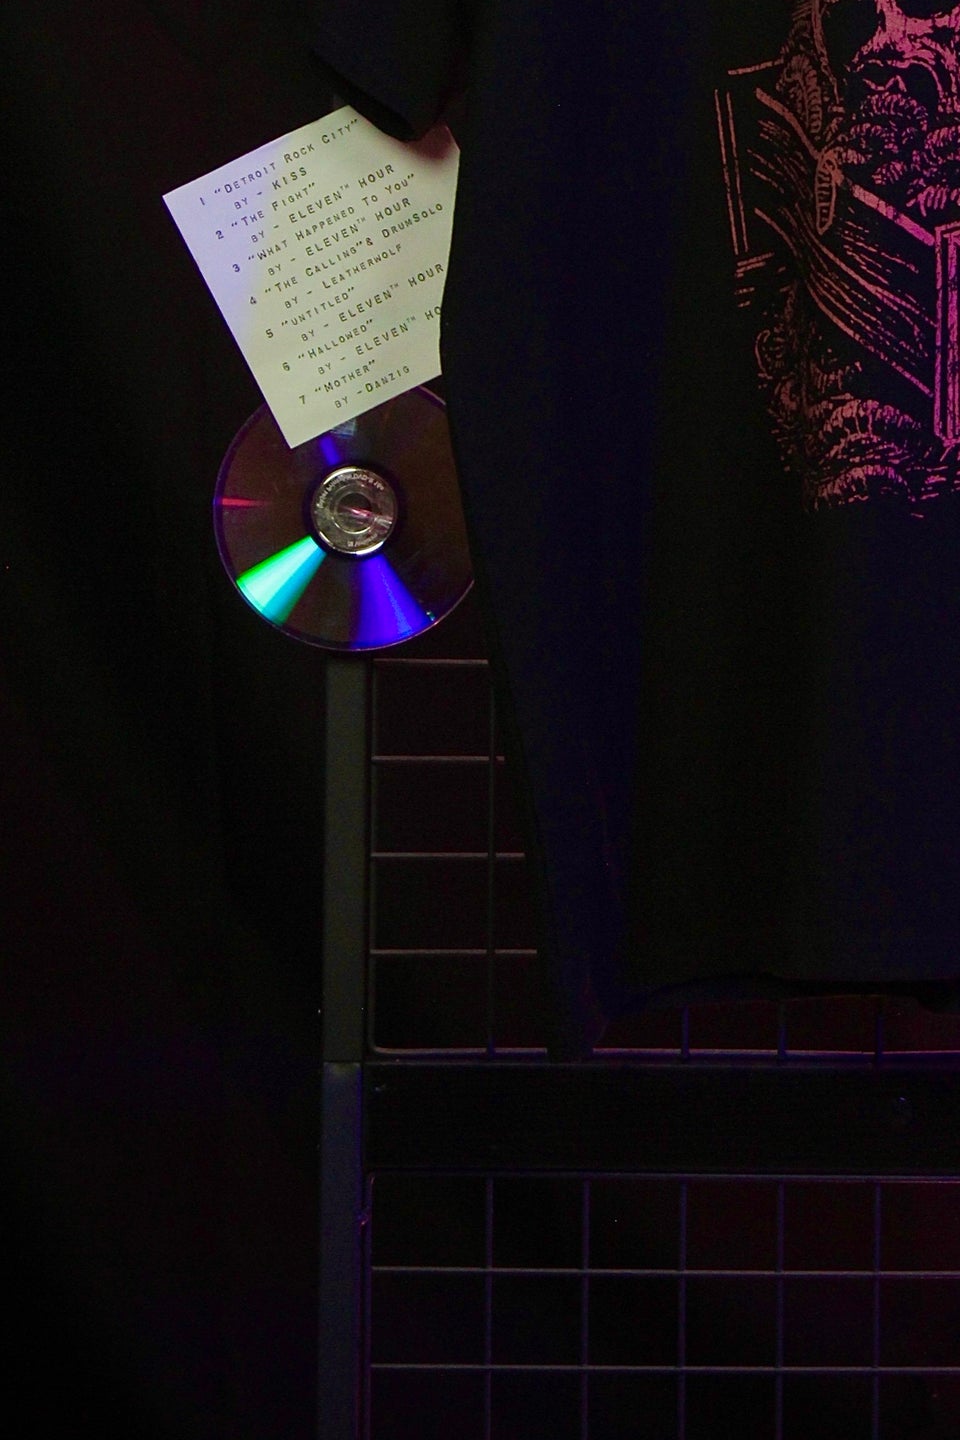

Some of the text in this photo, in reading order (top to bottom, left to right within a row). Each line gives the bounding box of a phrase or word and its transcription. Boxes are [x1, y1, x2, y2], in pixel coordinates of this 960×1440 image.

[199, 196, 206, 206] 1
[283, 143, 315, 164] ROCK
[233, 196, 249, 210] BY
[271, 166, 308, 191] KISS
[250, 229, 265, 244] BY
[357, 164, 395, 189] HOUR
[215, 229, 225, 240] 2
[232, 263, 241, 273] 3
[294, 206, 355, 242] HAPPENED
[360, 194, 379, 207] TO
[249, 296, 258, 305] 4
[380, 203, 444, 239] DRUMSOLO
[267, 263, 282, 277] BY
[374, 197, 412, 222] HOUR
[284, 295, 298, 309] BY
[321, 243, 402, 290] LEATHERWOLF
[300, 328, 315, 342] BY
[407, 263, 444, 288] HOUR
[265, 328, 274, 339] 5
[282, 361, 291, 372] 6
[317, 361, 332, 376] BY
[298, 394, 306, 405] 7
[334, 395, 349, 409] BY
